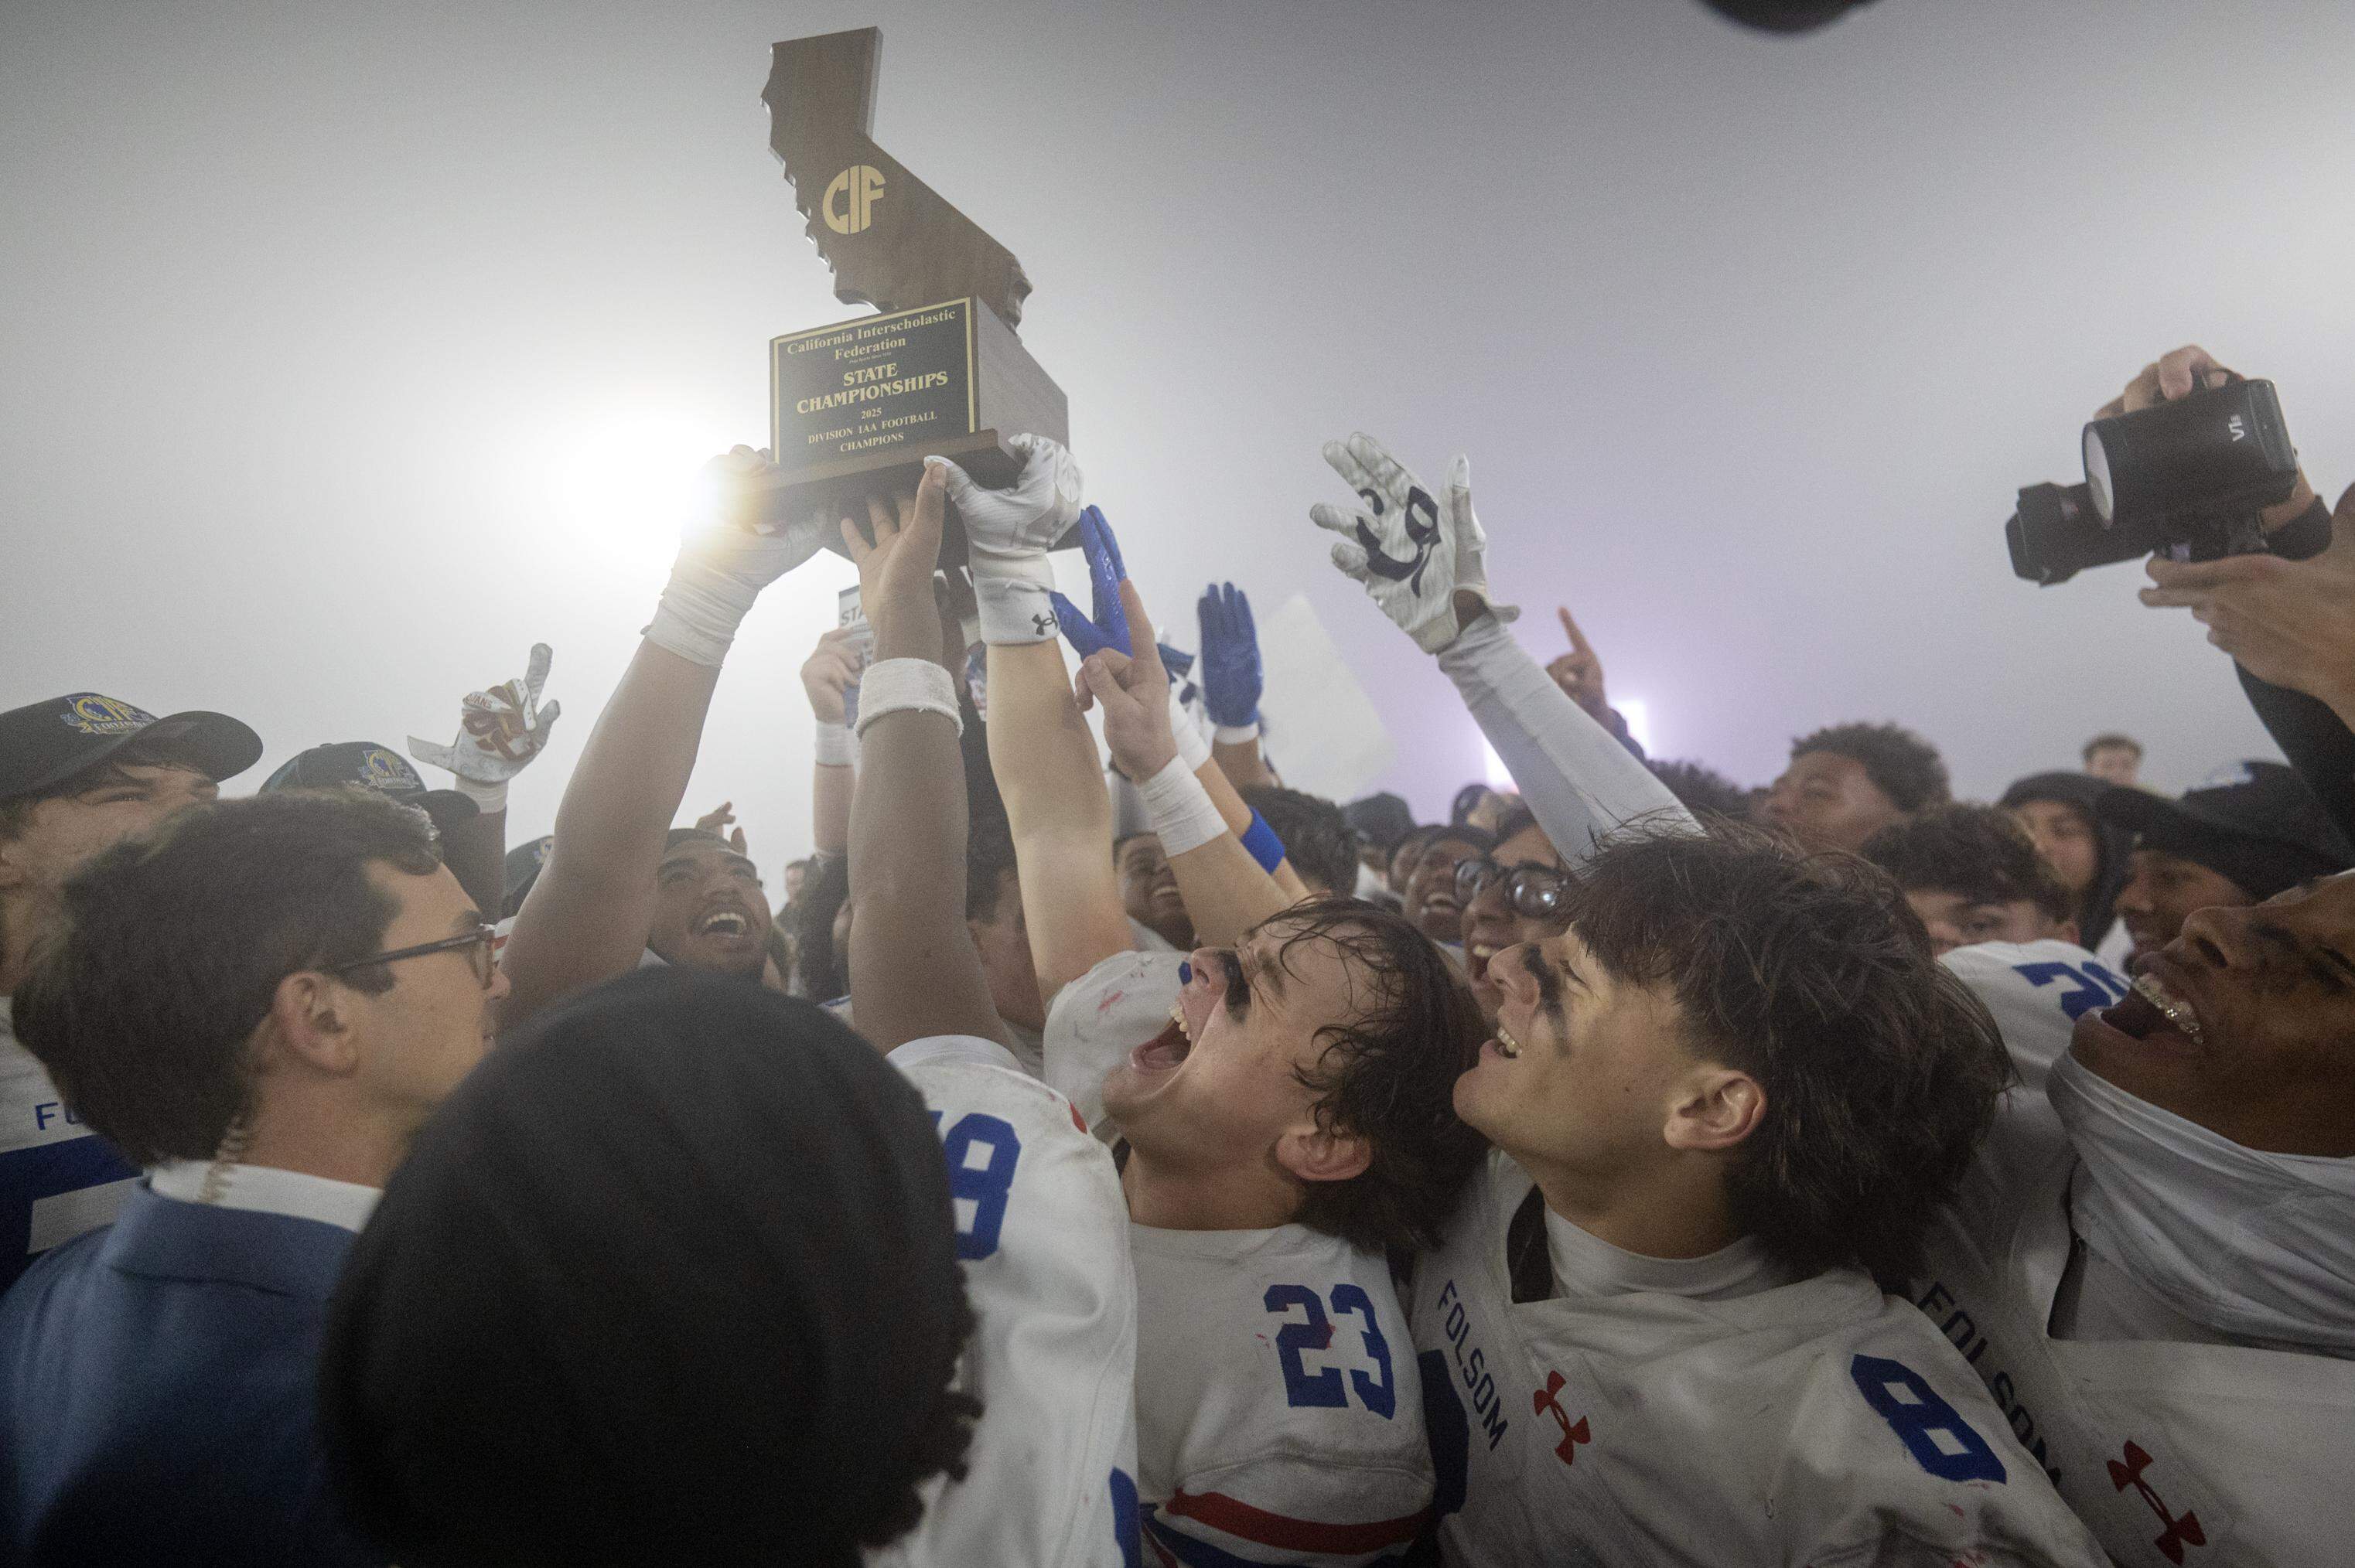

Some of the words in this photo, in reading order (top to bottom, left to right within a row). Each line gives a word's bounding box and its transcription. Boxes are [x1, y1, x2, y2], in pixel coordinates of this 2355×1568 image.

[823, 165, 886, 235] CIF
[787, 332, 853, 355] California
[858, 309, 956, 340] Interscholastic
[834, 337, 906, 360] Federation
[796, 371, 949, 414] CHAMPIONSHIPS
[843, 363, 898, 387] STATE
[808, 428, 853, 445] DIVISION
[882, 411, 937, 430] FOOTBALL
[861, 407, 882, 420] 2025
[840, 432, 904, 452] CHAMPIONS
[1263, 1283, 1396, 1420] 23
[1438, 1279, 1508, 1452] FOLSOM
[1850, 1354, 2008, 1485] 8
